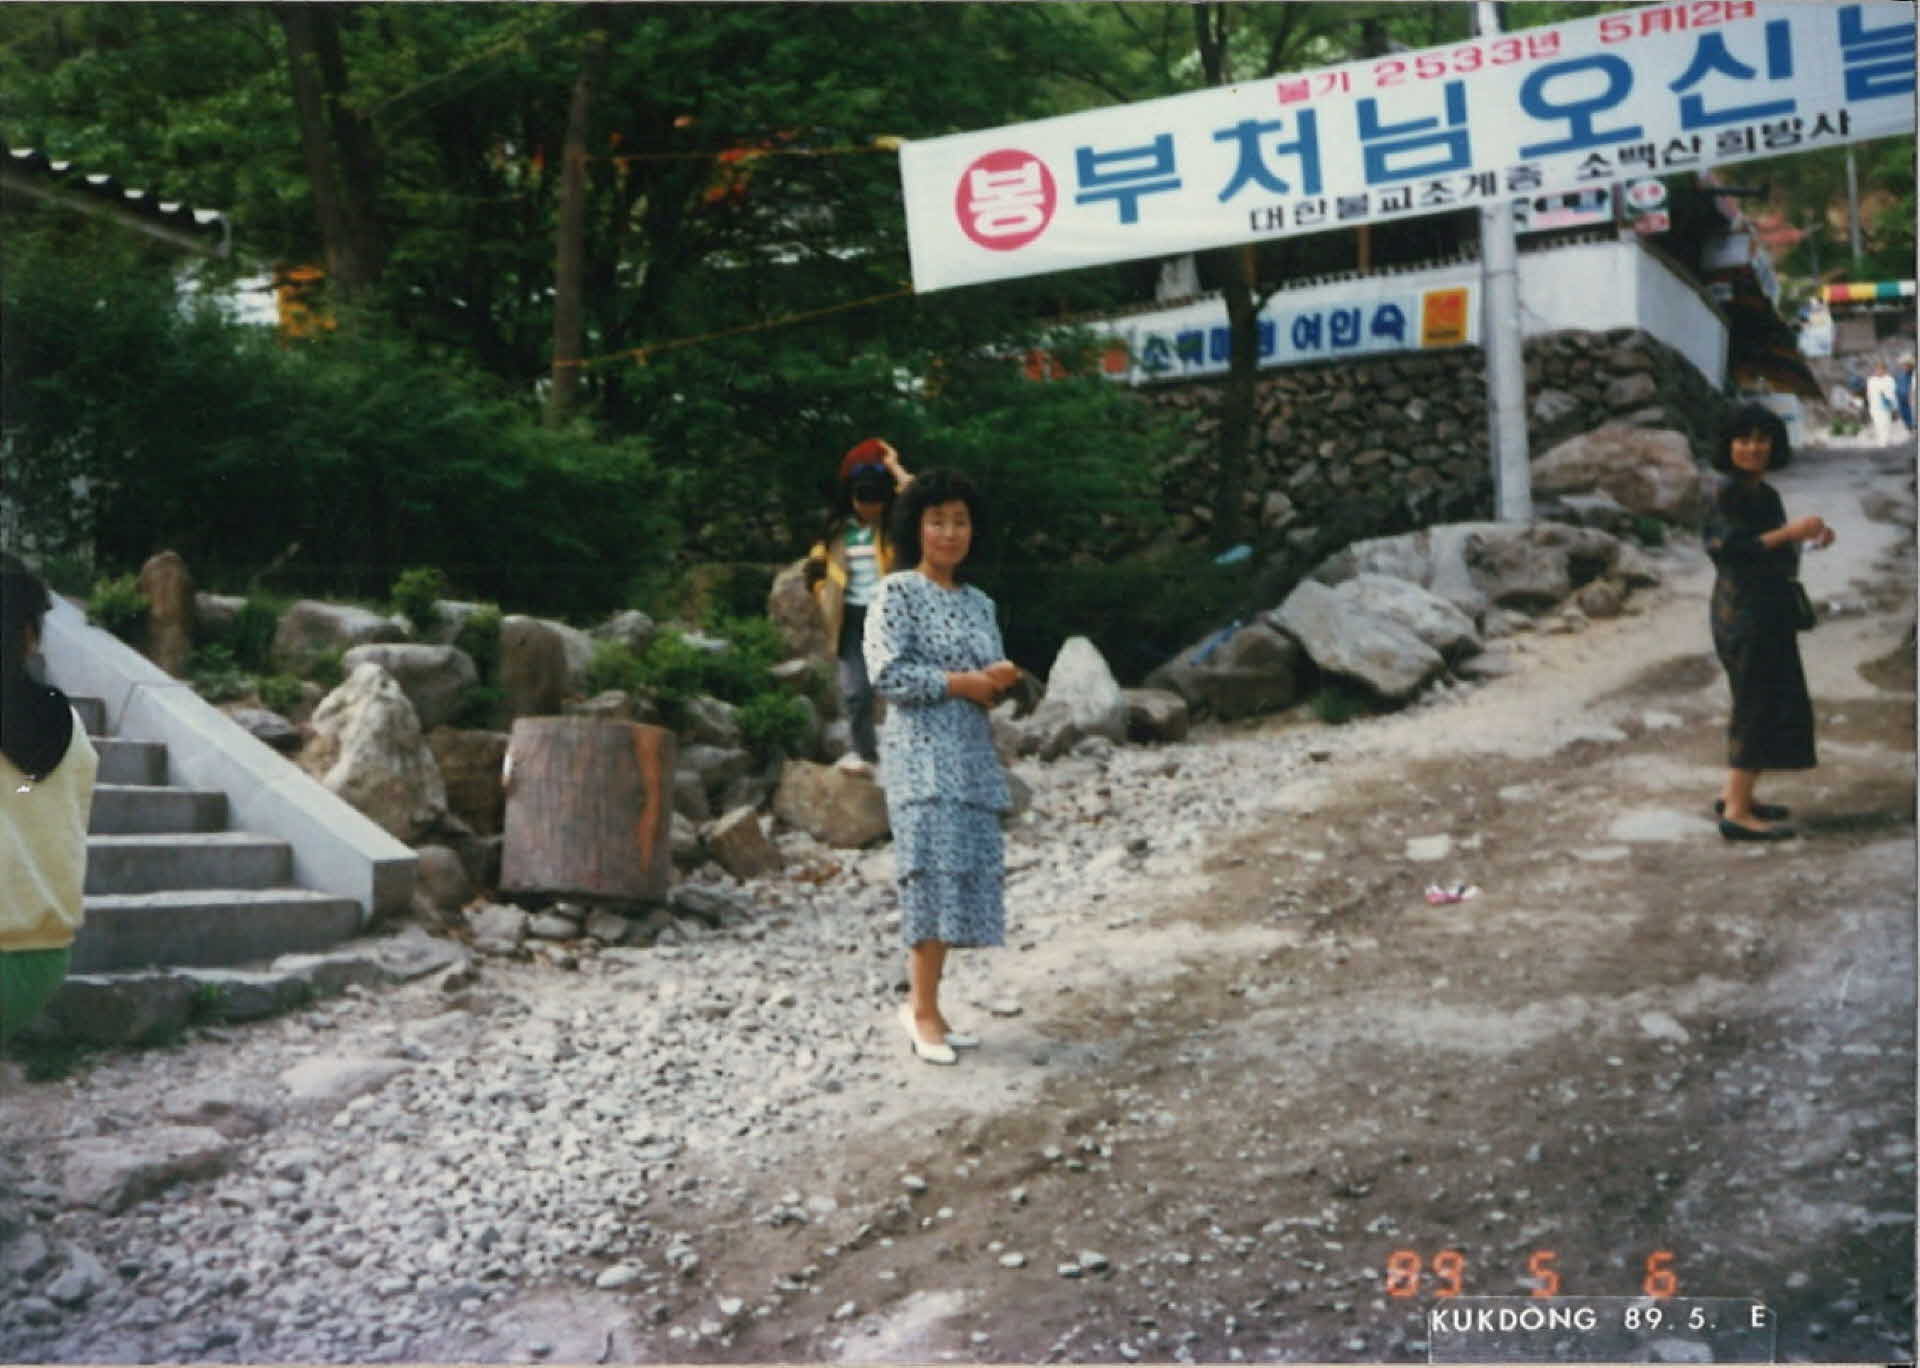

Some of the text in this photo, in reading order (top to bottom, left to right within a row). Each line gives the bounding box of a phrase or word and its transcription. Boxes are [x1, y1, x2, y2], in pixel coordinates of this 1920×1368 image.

[1277, 71, 1351, 104] 불기
[1372, 30, 1562, 87] 2533년
[967, 156, 1048, 240] 봉
[1249, 164, 1543, 232] 대한불교조계종
[1576, 135, 1702, 180] 소백산
[1715, 108, 1852, 156] 희방사
[1292, 303, 1406, 351] 여인숙
